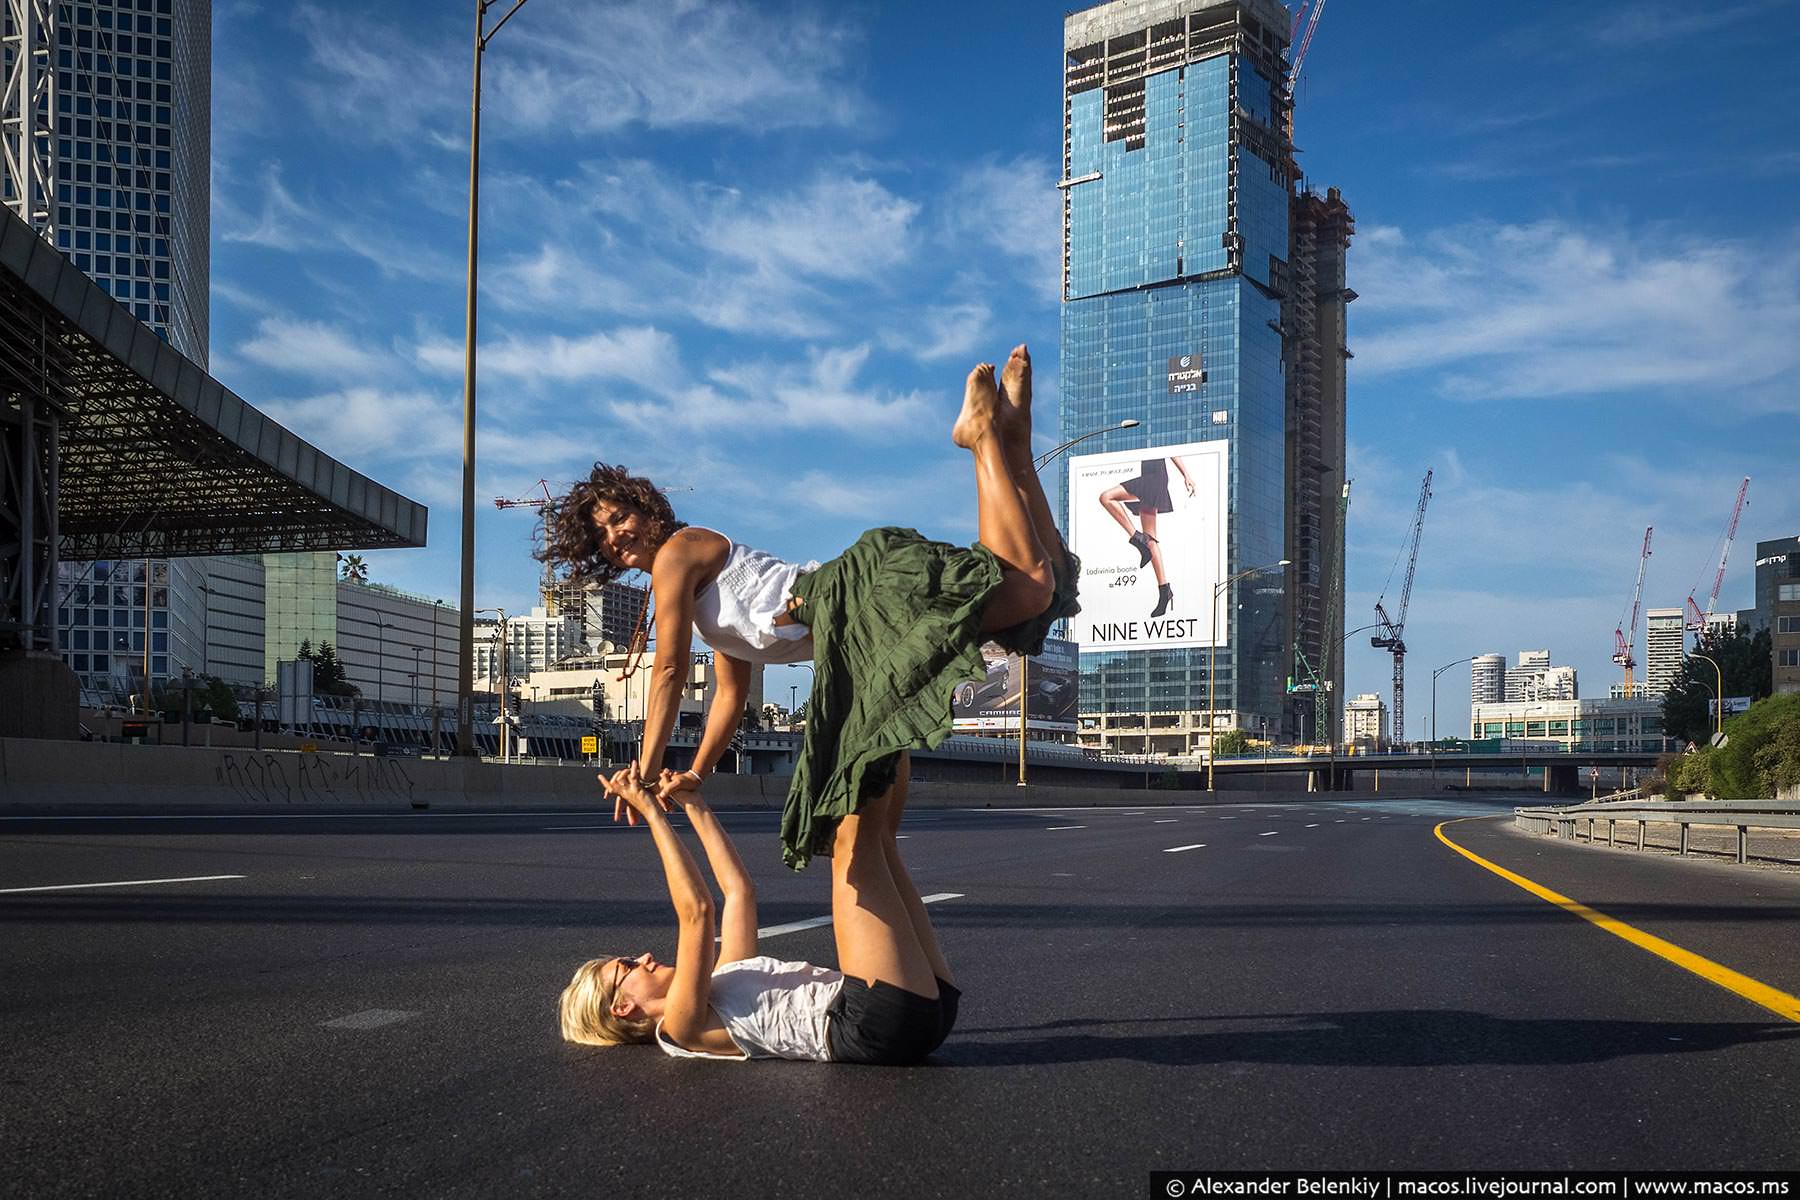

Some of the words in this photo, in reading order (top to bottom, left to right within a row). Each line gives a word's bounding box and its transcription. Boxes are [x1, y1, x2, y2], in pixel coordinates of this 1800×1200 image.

[1168, 369, 1202, 381] אלקטרה
[1173, 383, 1197, 393] בנייה
[1092, 622, 1138, 642] NINE
[1143, 618, 1198, 639] WEST
